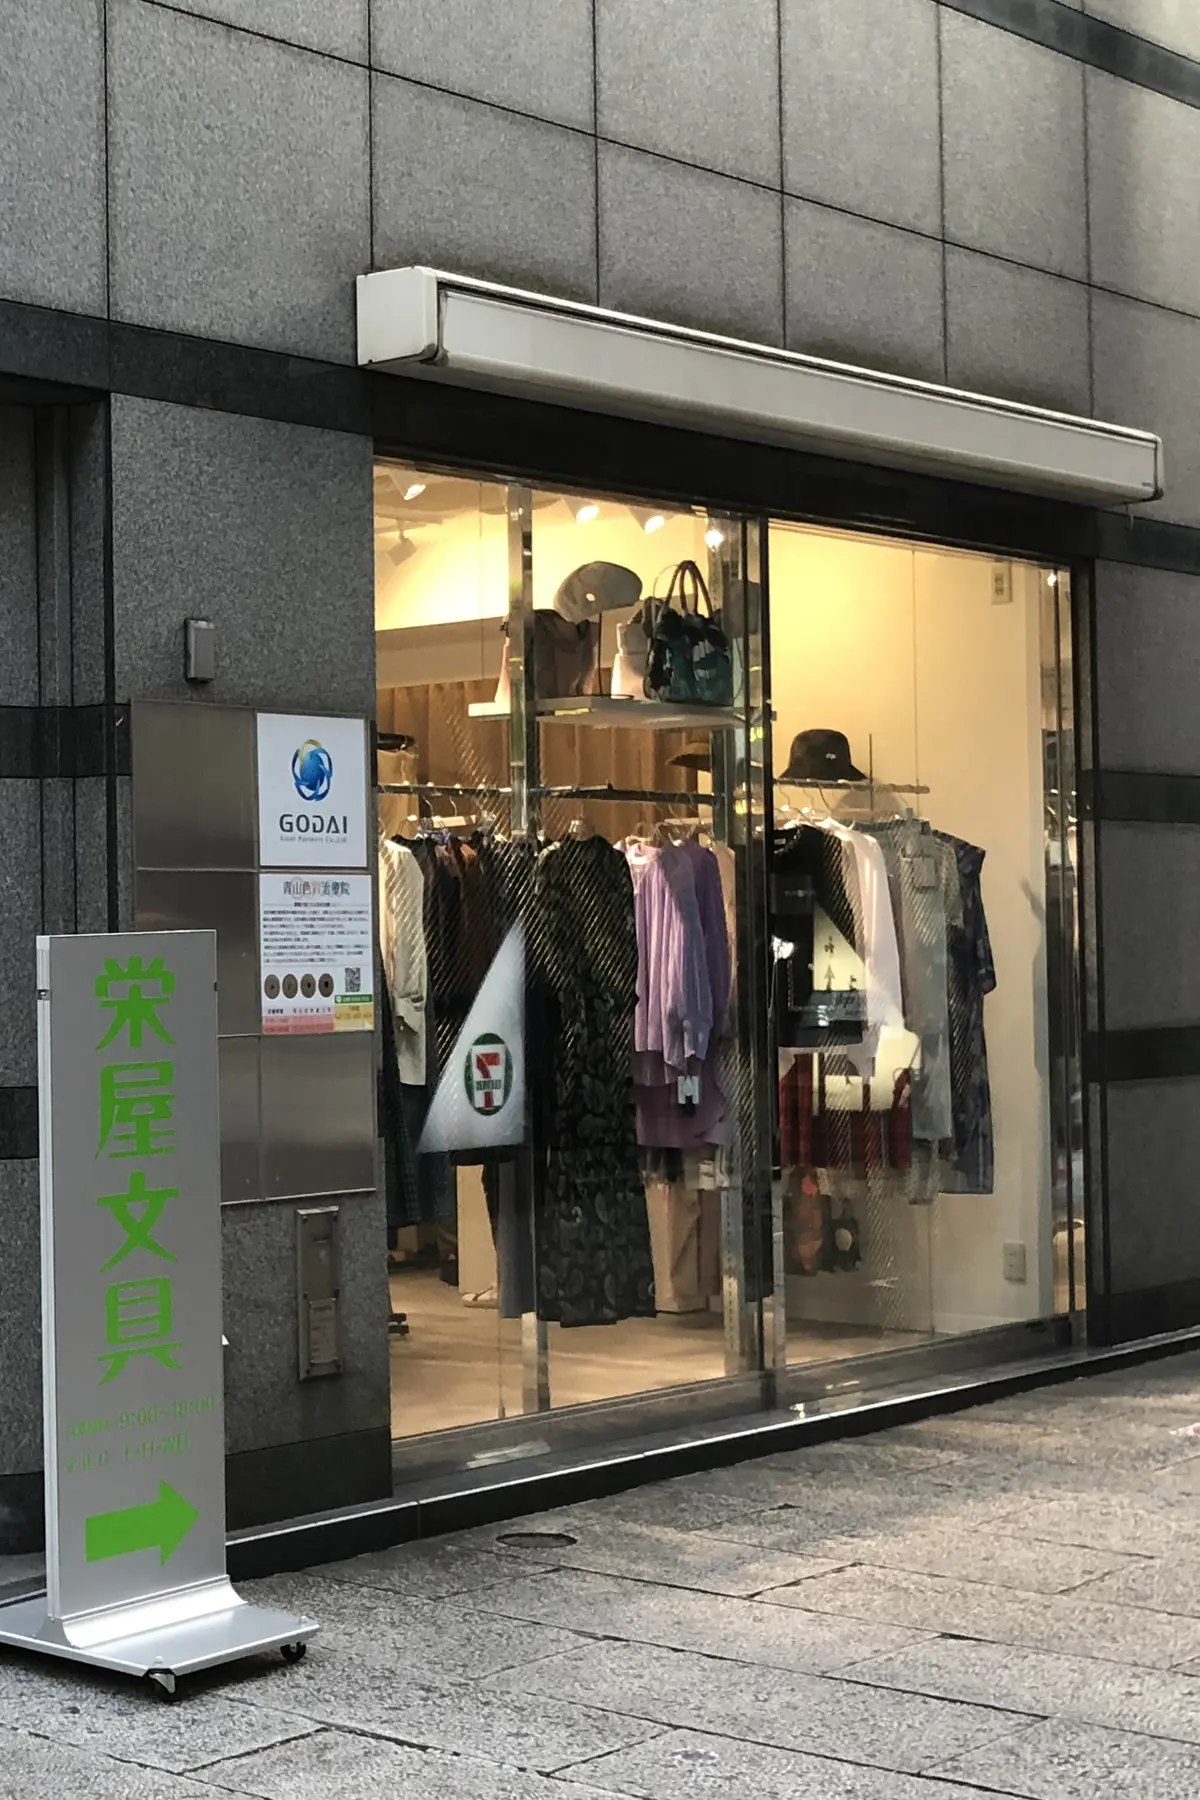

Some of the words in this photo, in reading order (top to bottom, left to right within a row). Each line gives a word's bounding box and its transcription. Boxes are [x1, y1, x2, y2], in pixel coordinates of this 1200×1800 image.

[279, 813, 348, 834] GODAI
[93, 954, 183, 1387] 栄屋文具
